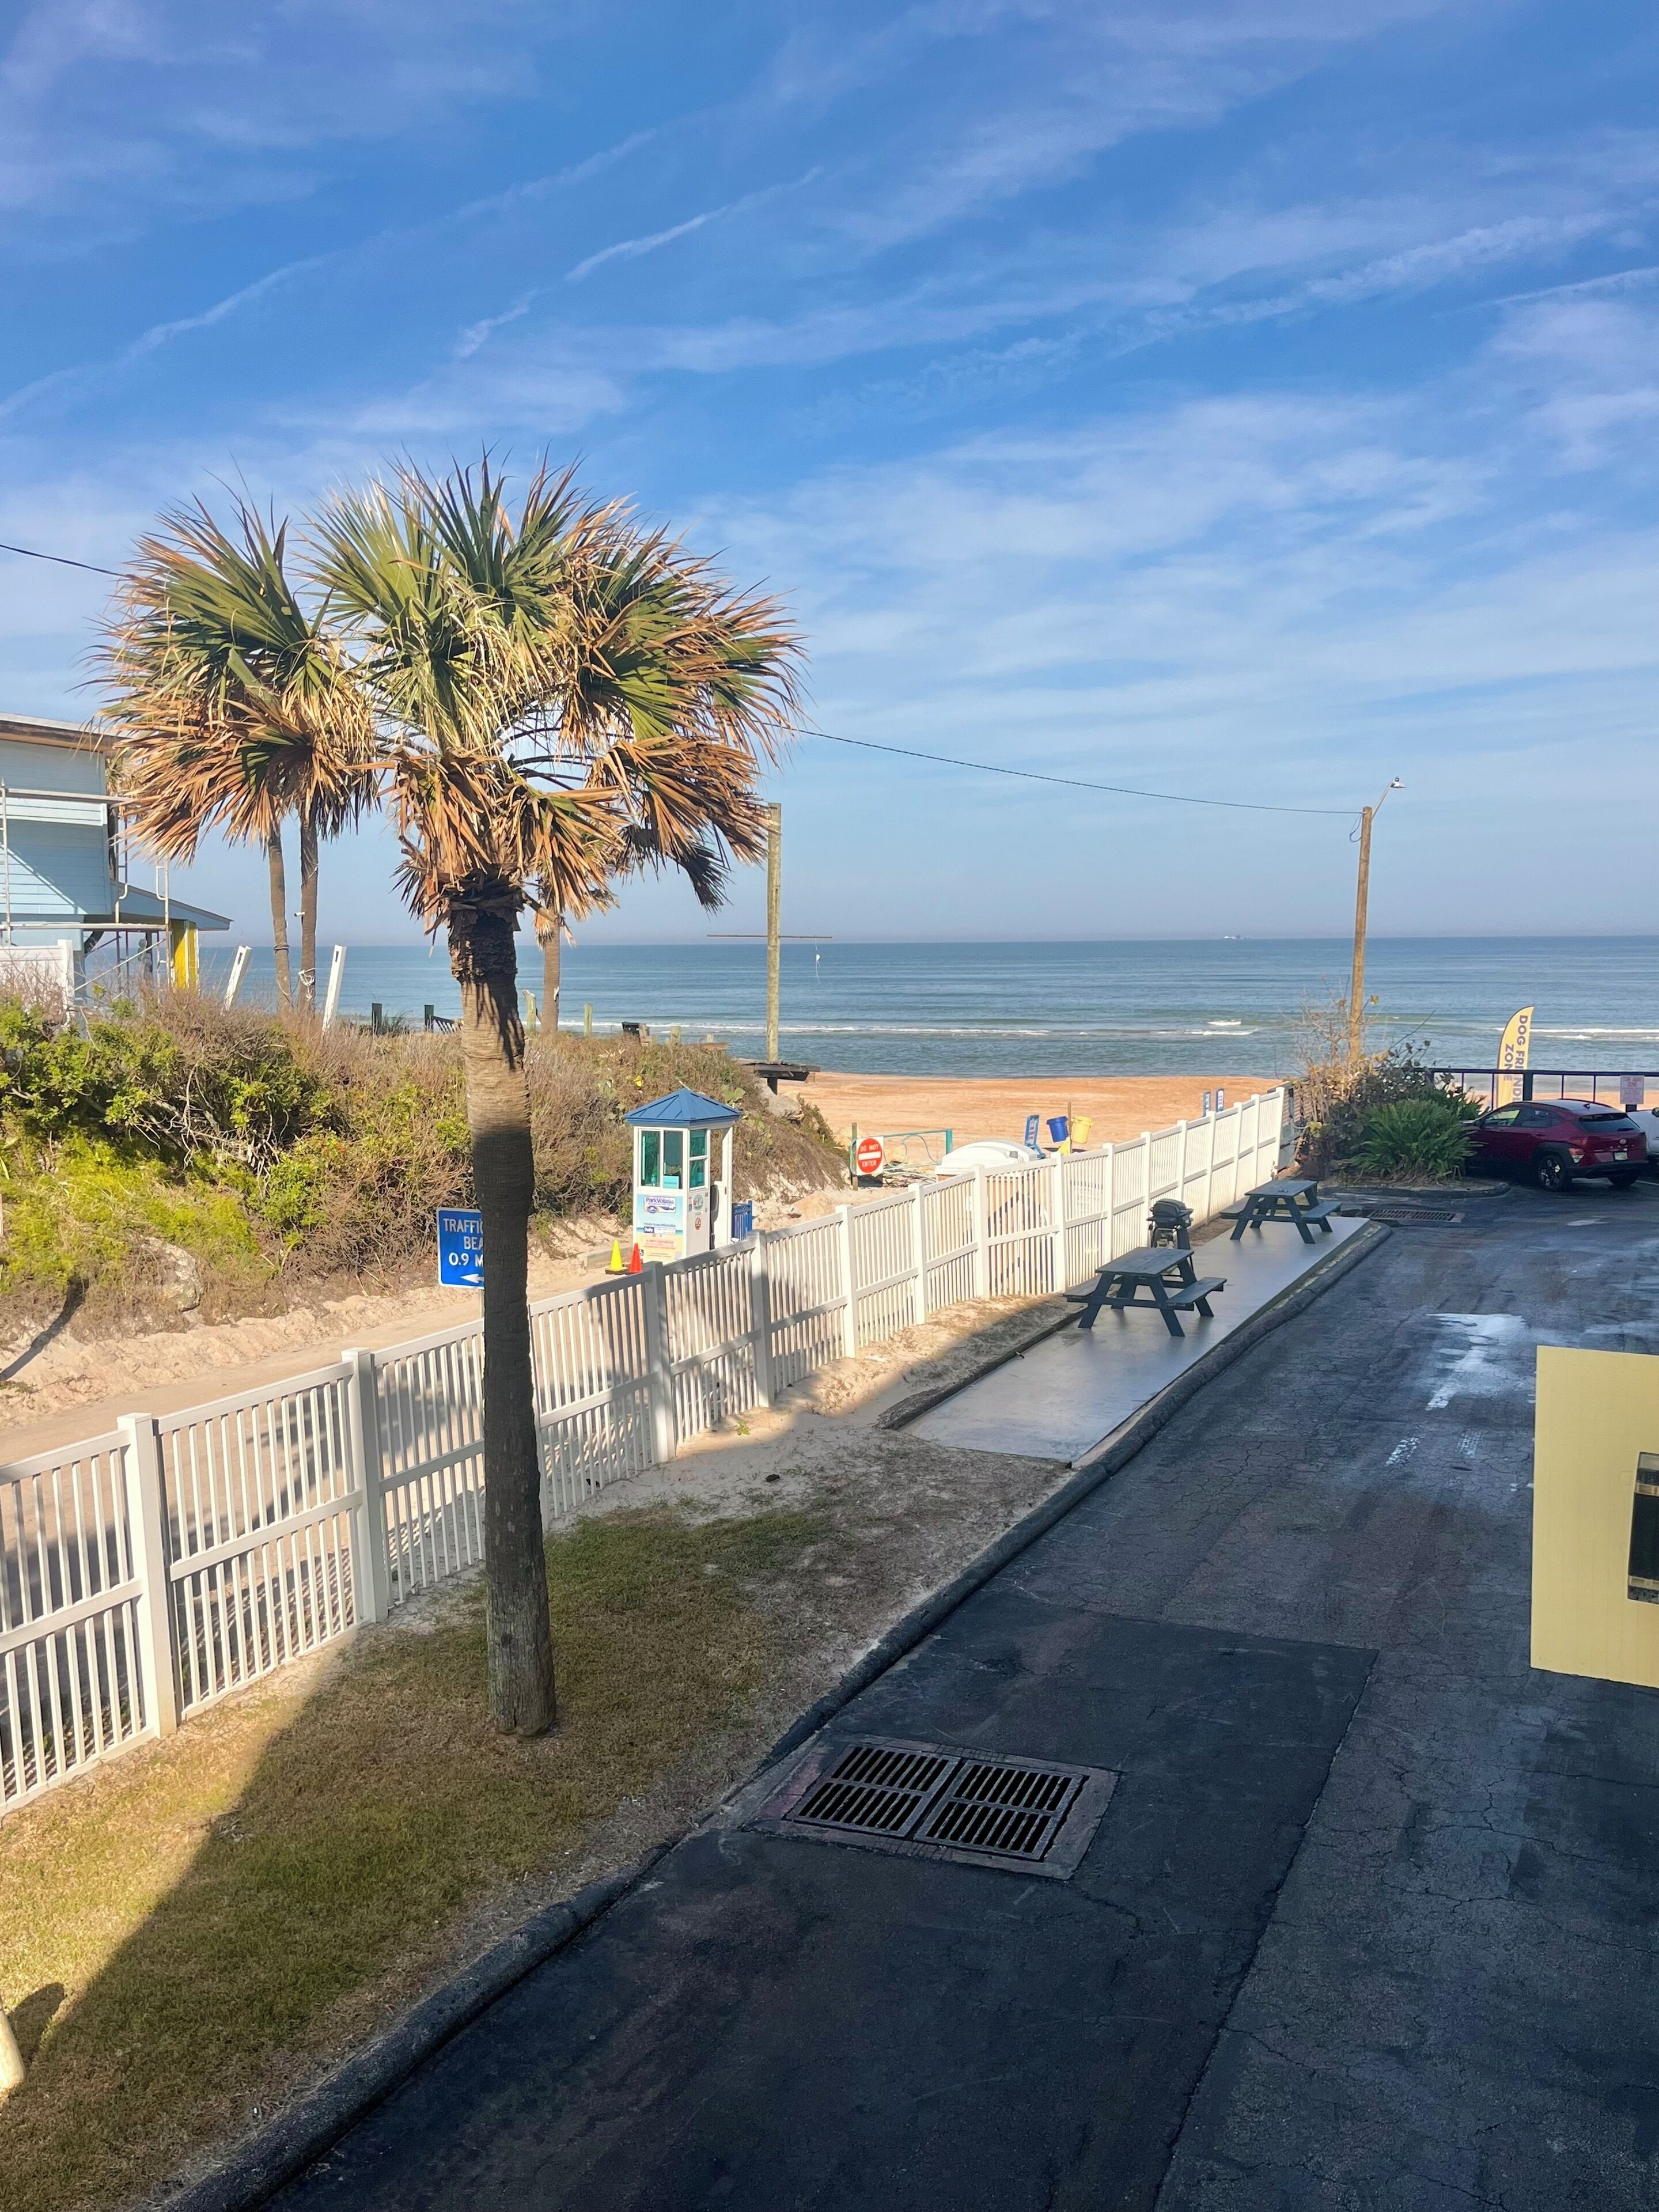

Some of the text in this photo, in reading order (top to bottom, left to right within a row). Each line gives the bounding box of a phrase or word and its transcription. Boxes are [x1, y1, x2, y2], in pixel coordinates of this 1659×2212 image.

[1517, 1015, 1528, 1046] DOG
[862, 1160, 877, 1168] ENTER
[449, 1252, 469, 1266] 0.9
